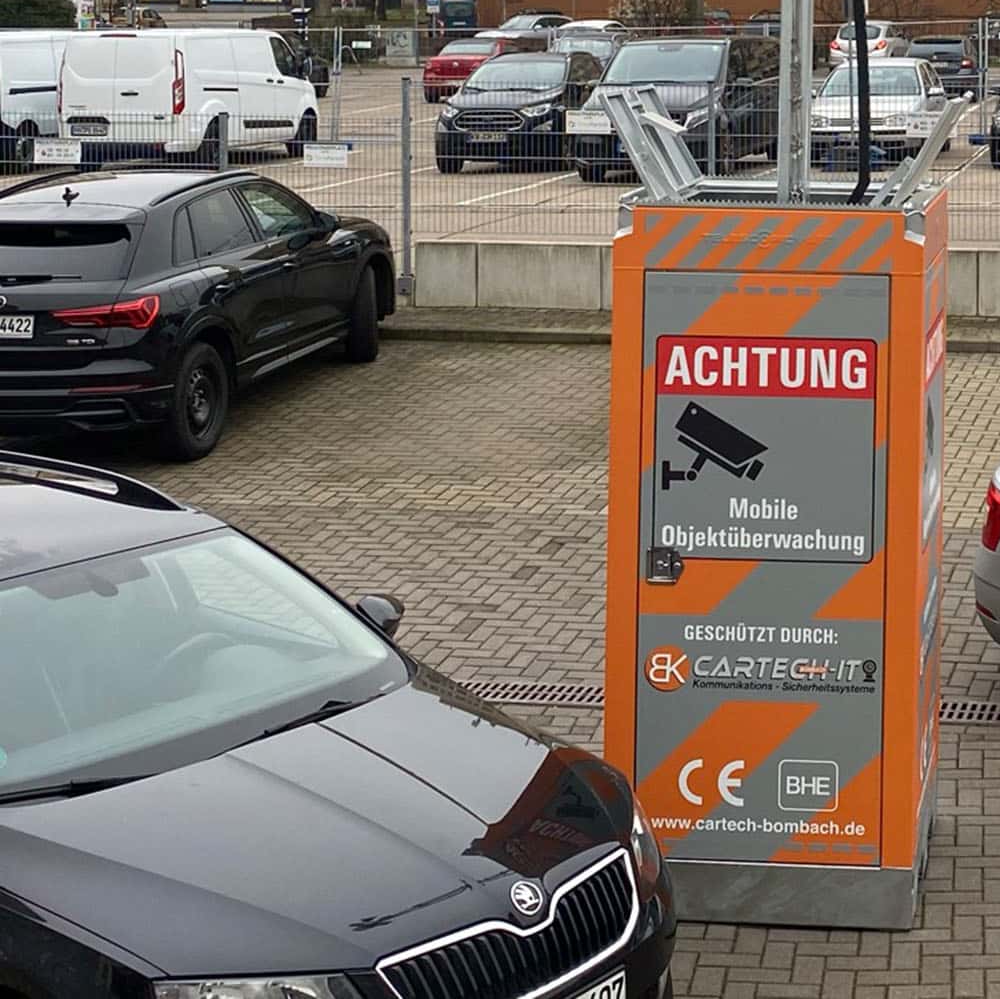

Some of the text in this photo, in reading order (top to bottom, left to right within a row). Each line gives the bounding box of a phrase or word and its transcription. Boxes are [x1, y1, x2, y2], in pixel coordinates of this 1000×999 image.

[664, 345, 868, 390] ACHTUNG
[729, 497, 798, 520] Mobile
[661, 524, 865, 556] Objektüberwachung
[684, 622, 839, 645] GESCHÜTZT DURCH:
[692, 679, 773, 691] Kommunikations
[782, 681, 876, 695] Sicherheitssysteme
[786, 776, 830, 796] BHE
[651, 816, 866, 836] www.cartech-bombach.de
